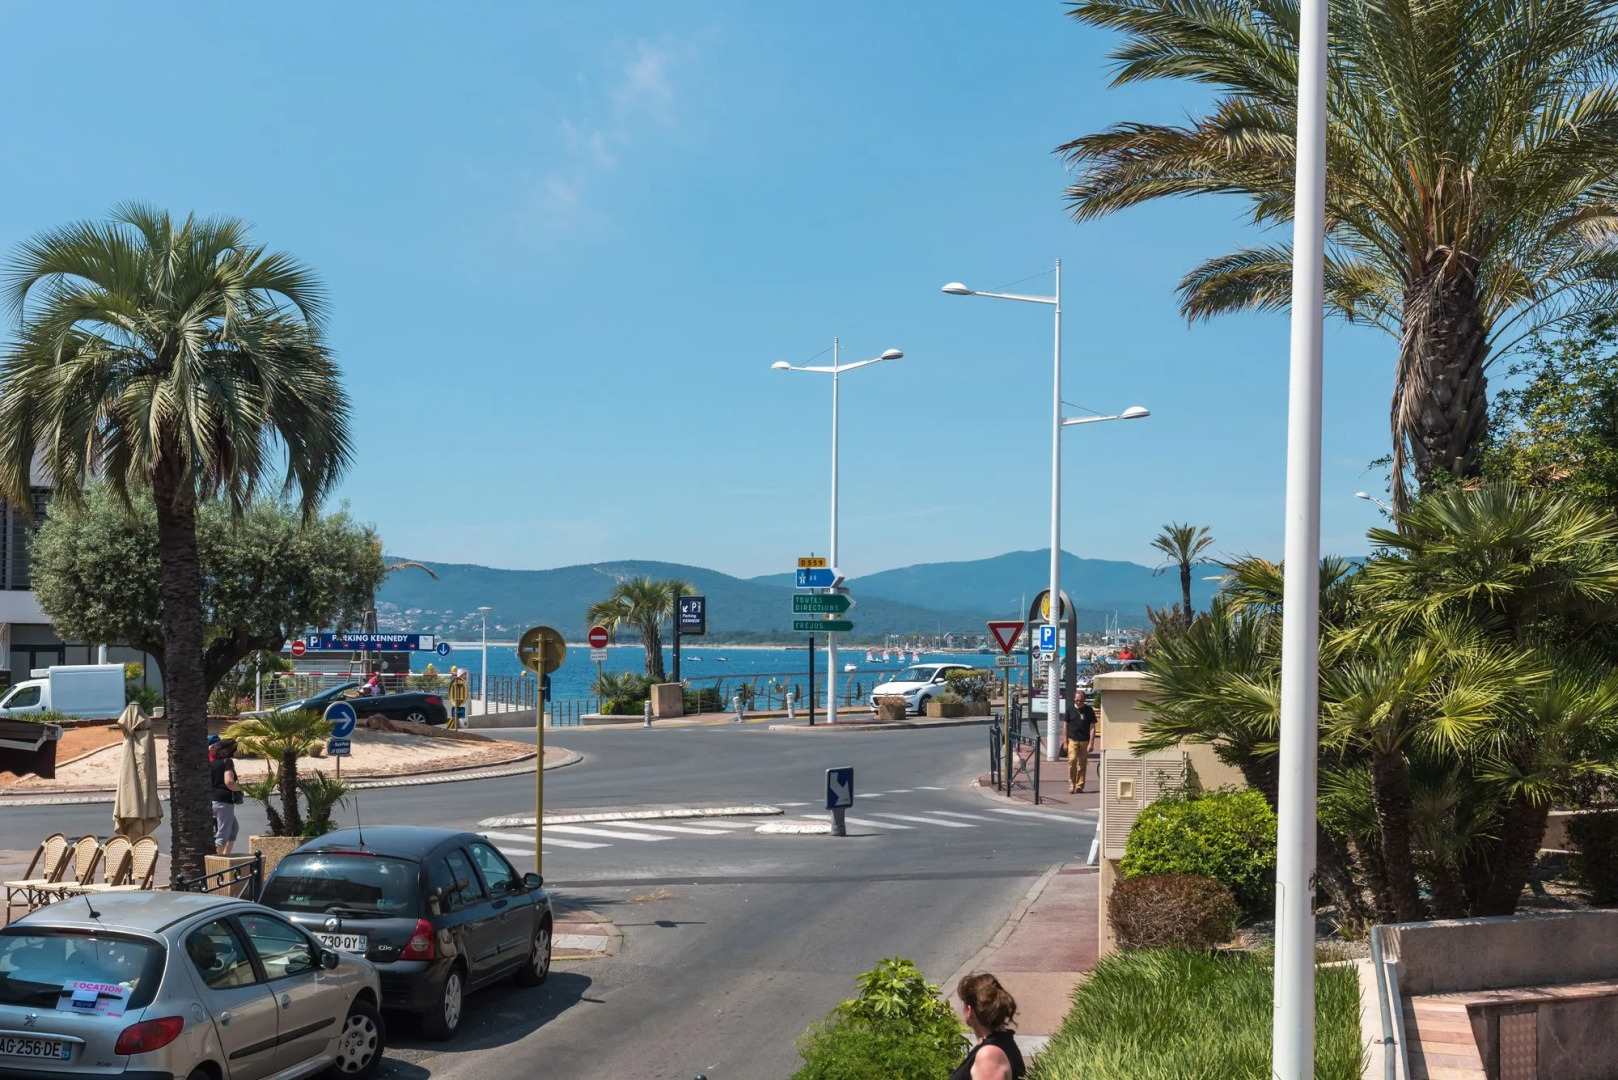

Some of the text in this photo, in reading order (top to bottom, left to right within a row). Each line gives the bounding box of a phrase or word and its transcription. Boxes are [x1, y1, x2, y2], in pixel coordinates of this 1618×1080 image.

[692, 602, 697, 611] P
[370, 634, 408, 642] KENNEDY
[1044, 628, 1051, 641] P
[310, 636, 318, 647] P
[72, 982, 123, 994] LOCATION
